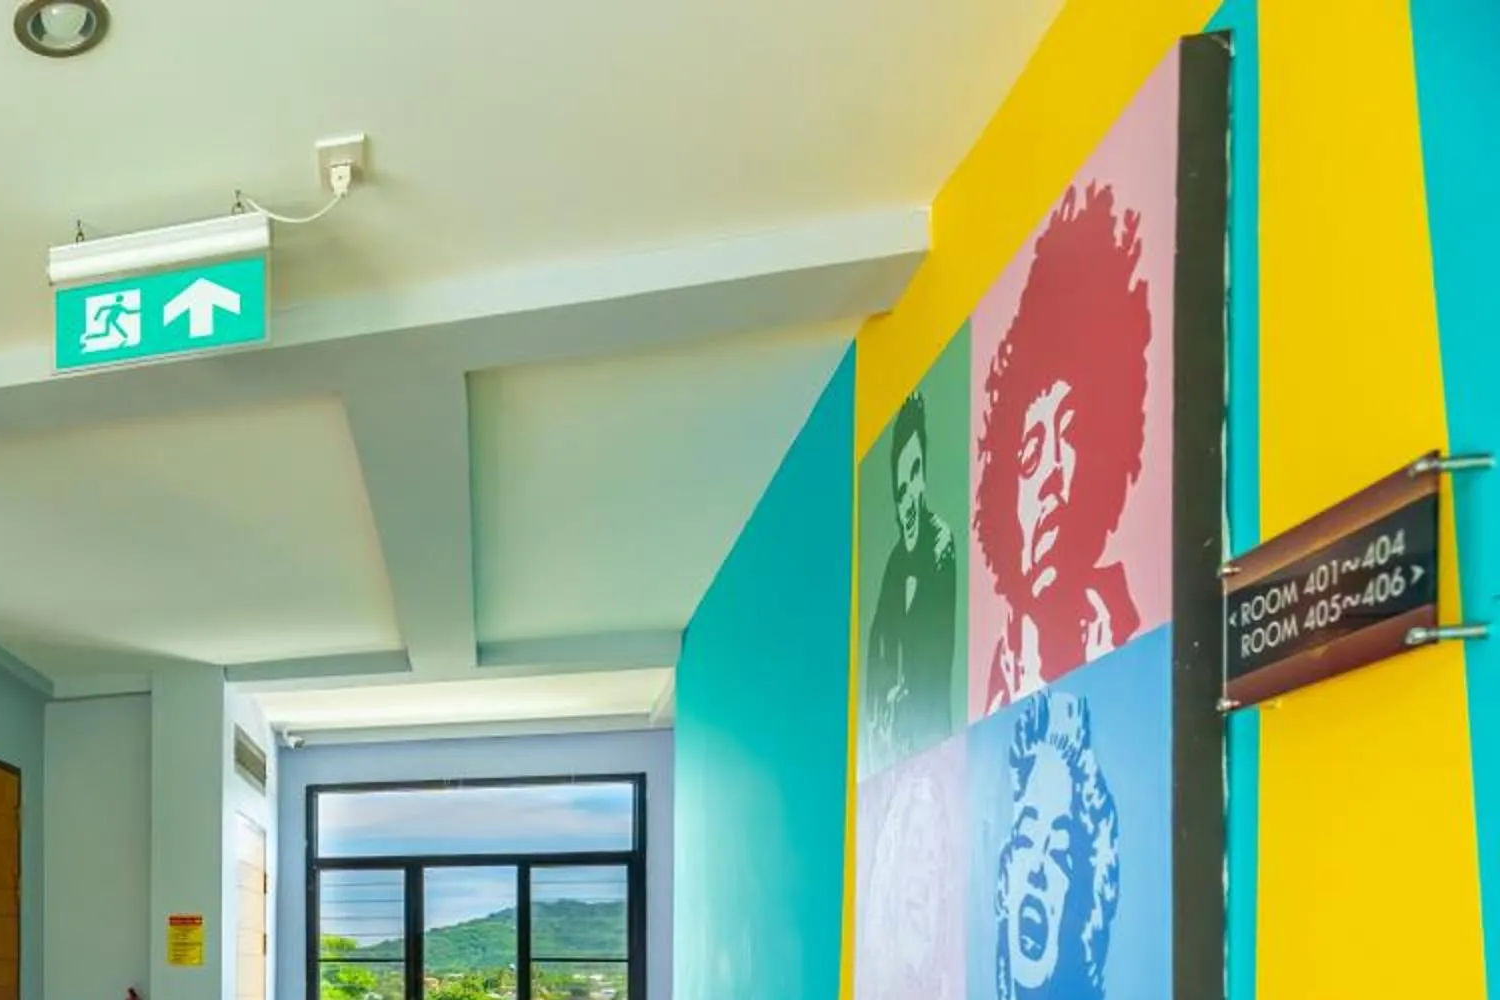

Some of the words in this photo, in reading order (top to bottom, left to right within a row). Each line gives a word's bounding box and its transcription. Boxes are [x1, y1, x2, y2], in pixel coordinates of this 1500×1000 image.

[1241, 581, 1298, 626] ROOM
[1303, 529, 1406, 594] 401~404
[1241, 614, 1298, 658] ROOM
[1303, 567, 1406, 630] 405~406
